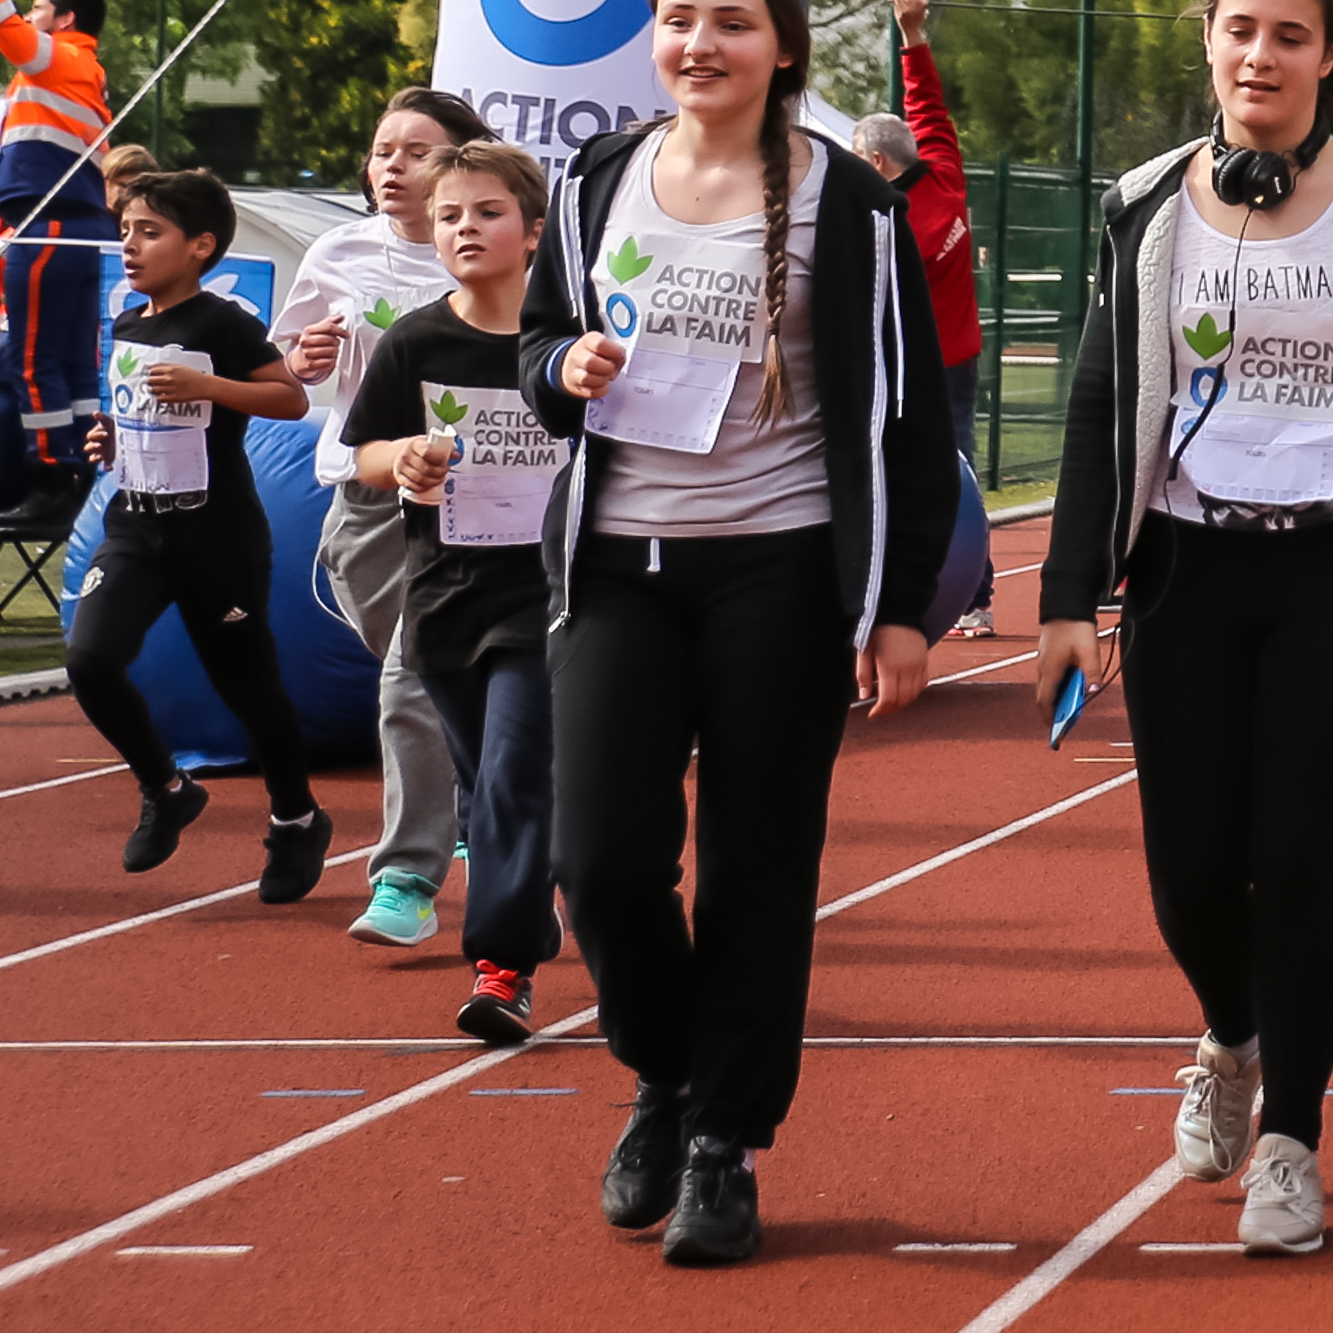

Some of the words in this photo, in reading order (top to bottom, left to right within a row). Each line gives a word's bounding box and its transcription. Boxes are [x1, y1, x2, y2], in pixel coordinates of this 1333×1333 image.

[656, 264, 762, 297] ACTION
[1179, 272, 1184, 305] I
[1195, 268, 1231, 303] AM
[651, 289, 757, 321] CONTRE
[646, 312, 678, 336] LA
[685, 318, 751, 347] FAIM
[1238, 382, 1268, 404] LA
[155, 403, 202, 418] FAIM
[474, 410, 541, 428] ACTIO
[472, 448, 497, 466] LA
[503, 449, 557, 467] FAIM
